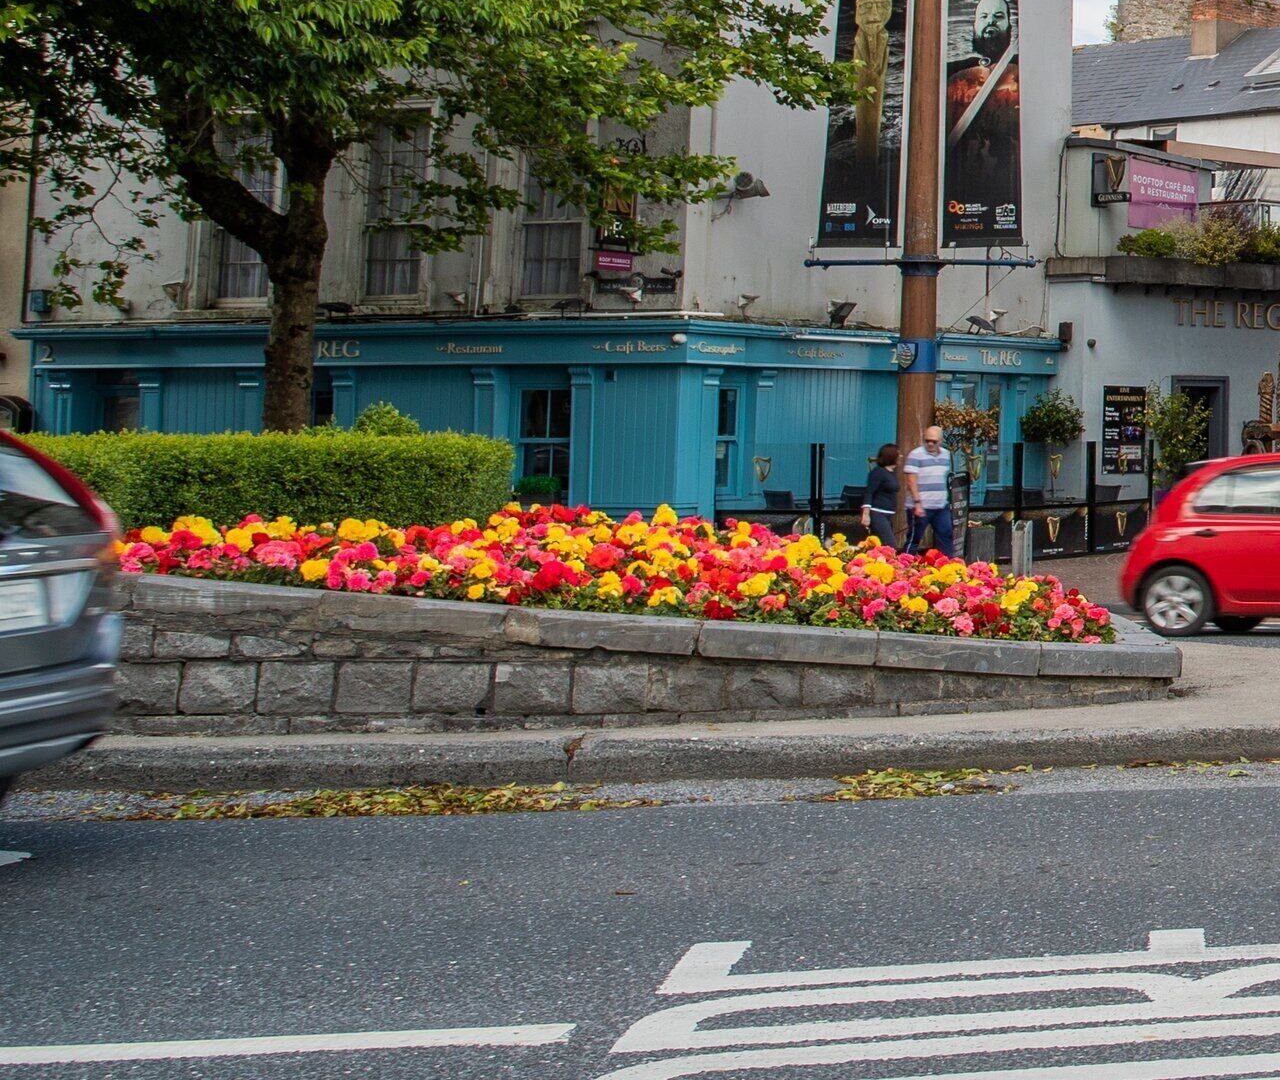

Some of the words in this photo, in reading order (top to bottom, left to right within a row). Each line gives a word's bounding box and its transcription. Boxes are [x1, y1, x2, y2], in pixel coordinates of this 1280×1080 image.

[1132, 174, 1163, 187] ROOFTOP
[1182, 185, 1195, 194] BAR
[1140, 186, 1146, 194] &
[1147, 188, 1188, 201] RESTAURANT
[1173, 298, 1226, 328] THE
[40, 345, 53, 362] 2
[317, 340, 361, 359] REG
[447, 342, 503, 354] Restaurant
[605, 340, 633, 354] Craft
[638, 340, 667, 352] Beers
[979, 349, 998, 366] The
[999, 351, 1022, 366] REG
